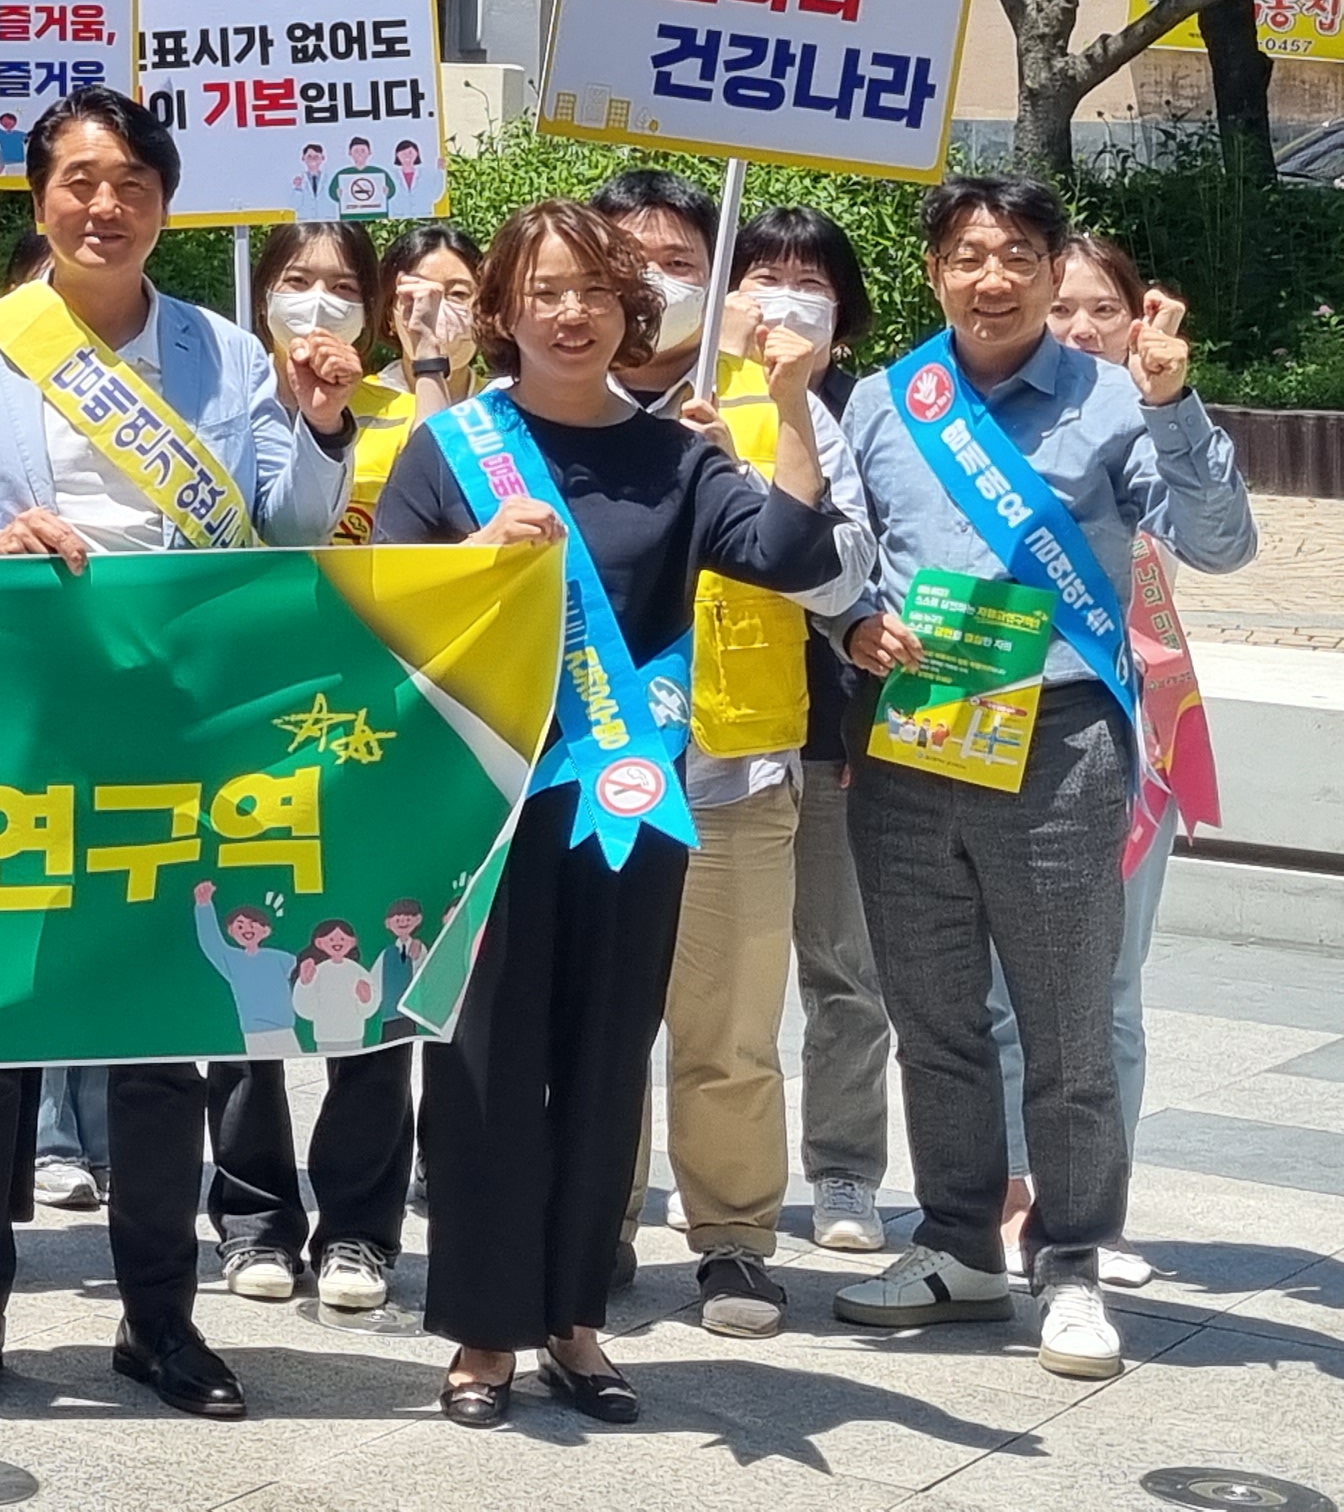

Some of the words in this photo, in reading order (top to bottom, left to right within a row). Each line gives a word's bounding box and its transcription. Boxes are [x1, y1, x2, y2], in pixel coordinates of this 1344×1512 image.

[286, 19, 411, 64] 없어도
[650, 23, 937, 129] 건강나라
[203, 78, 435, 128] 기본입니다.
[50, 343, 200, 488] 담배연기
[939, 417, 1034, 528] 함께해요
